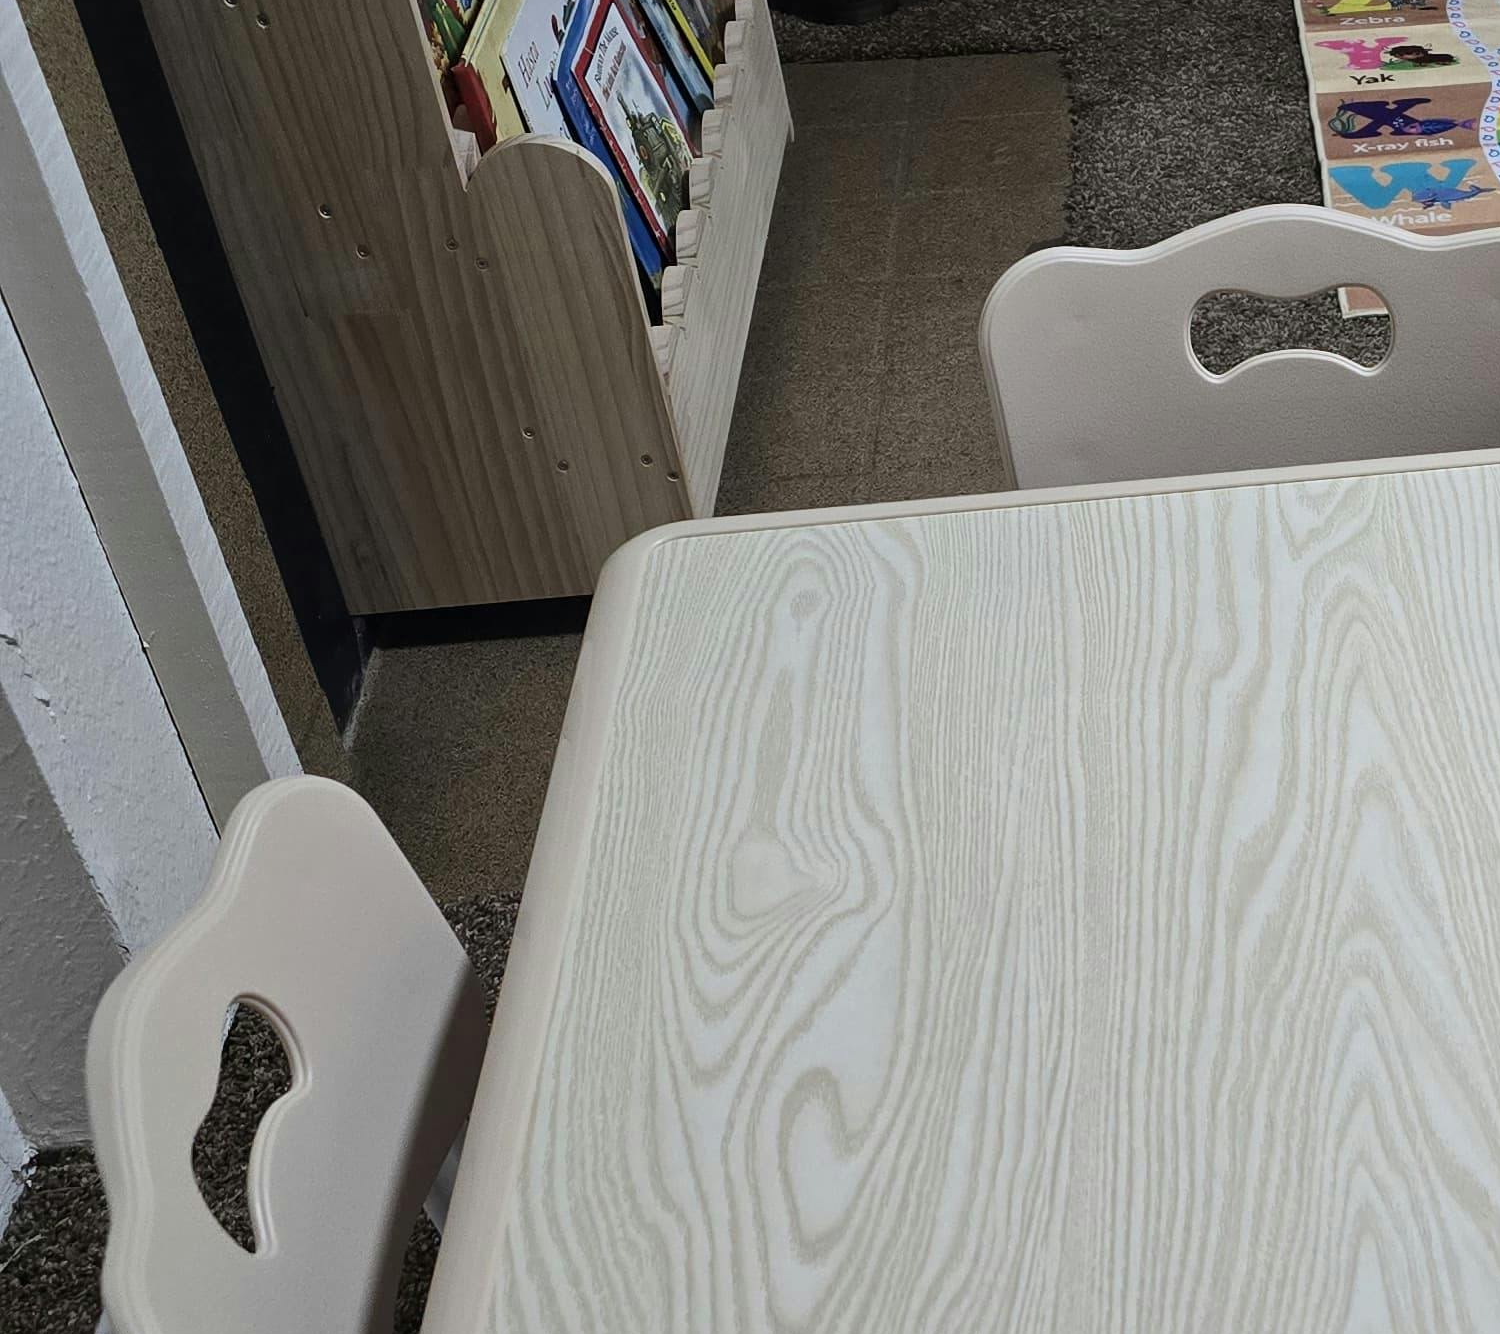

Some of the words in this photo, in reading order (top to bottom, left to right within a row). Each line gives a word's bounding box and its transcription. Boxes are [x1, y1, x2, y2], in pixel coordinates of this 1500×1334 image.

[1340, 16, 1406, 26] Zebra
[518, 41, 540, 88] Hasta
[1314, 37, 1409, 70] Y
[1350, 73, 1396, 86] Yak
[1338, 97, 1432, 139] X
[1353, 140, 1410, 154] X-ray
[1414, 136, 1454, 148] fish
[1328, 158, 1477, 210] W
[1371, 211, 1453, 229] Whale
